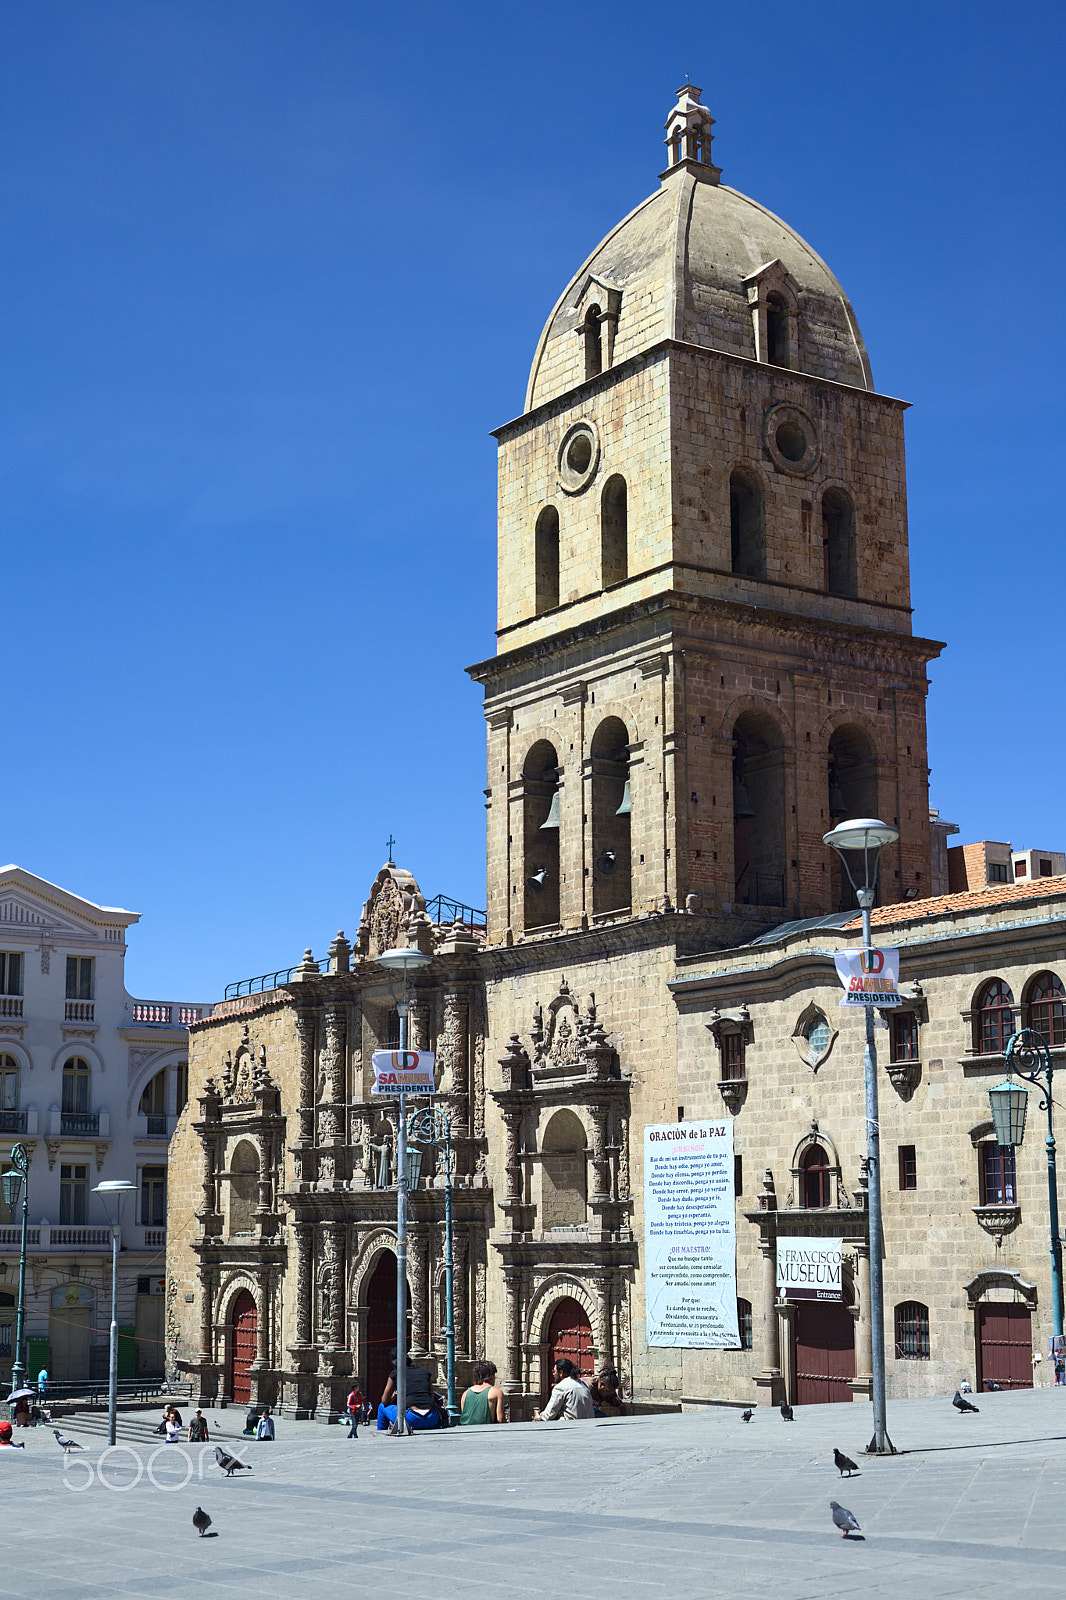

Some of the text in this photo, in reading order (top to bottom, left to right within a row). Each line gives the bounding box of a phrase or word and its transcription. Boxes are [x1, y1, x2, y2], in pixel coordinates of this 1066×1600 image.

[858, 950, 884, 974] UD
[849, 977, 897, 993] SAMUEL
[848, 993, 901, 1001] PRESIDENTE
[392, 1052, 419, 1070] UD
[379, 1073, 433, 1084] SAMUEL
[650, 1127, 726, 1141] ORACIÓN de la PAZ
[670, 1246, 680, 1254] ¡OH
[786, 1250, 842, 1263] FRANCISCO
[778, 1263, 840, 1283] MUSEUM
[817, 1290, 841, 1299] Entrance
